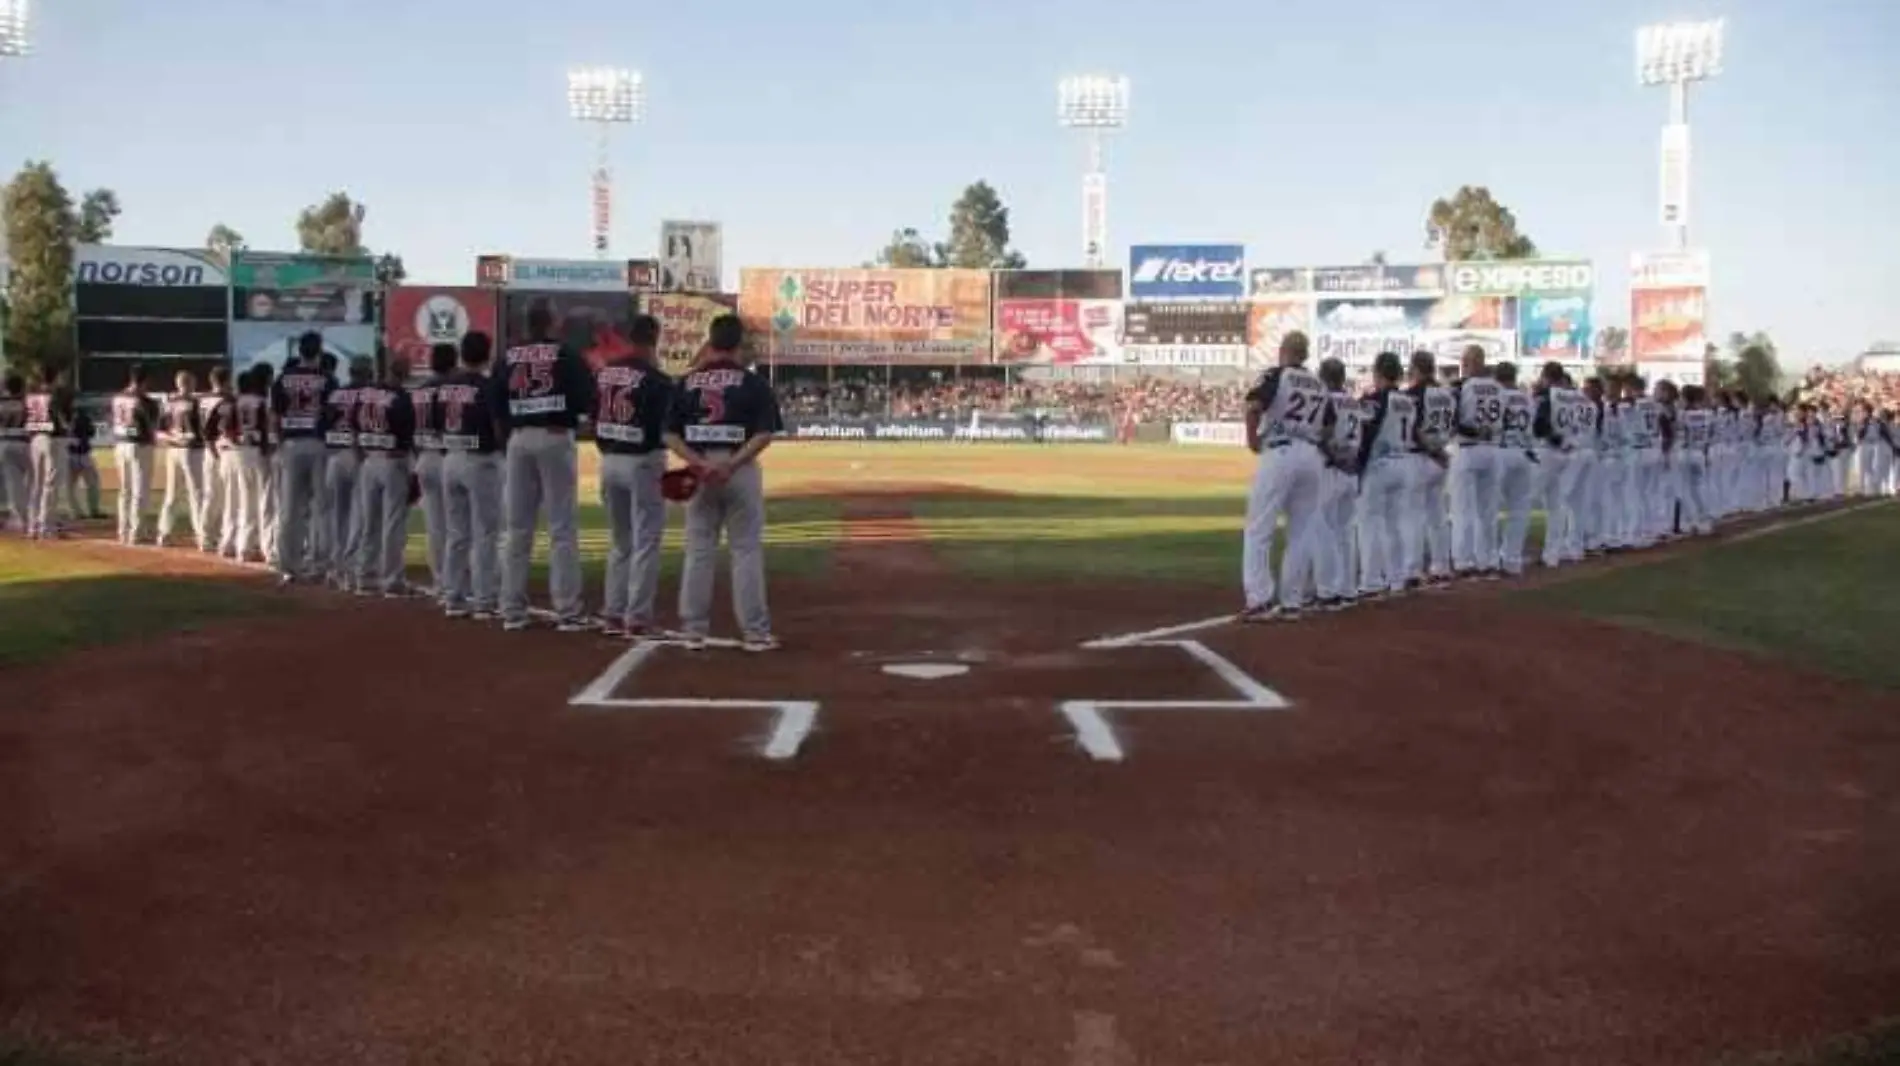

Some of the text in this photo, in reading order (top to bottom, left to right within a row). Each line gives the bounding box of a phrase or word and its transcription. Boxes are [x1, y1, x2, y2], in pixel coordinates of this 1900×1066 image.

[78, 261, 204, 285] norson
[805, 280, 897, 302] SUPER
[804, 304, 955, 328] DEL NORTE
[508, 362, 554, 398] 45
[600, 385, 635, 423] 16
[1285, 391, 1324, 424] 27
[797, 423, 864, 438] infinitum
[875, 423, 944, 438] infinitum
